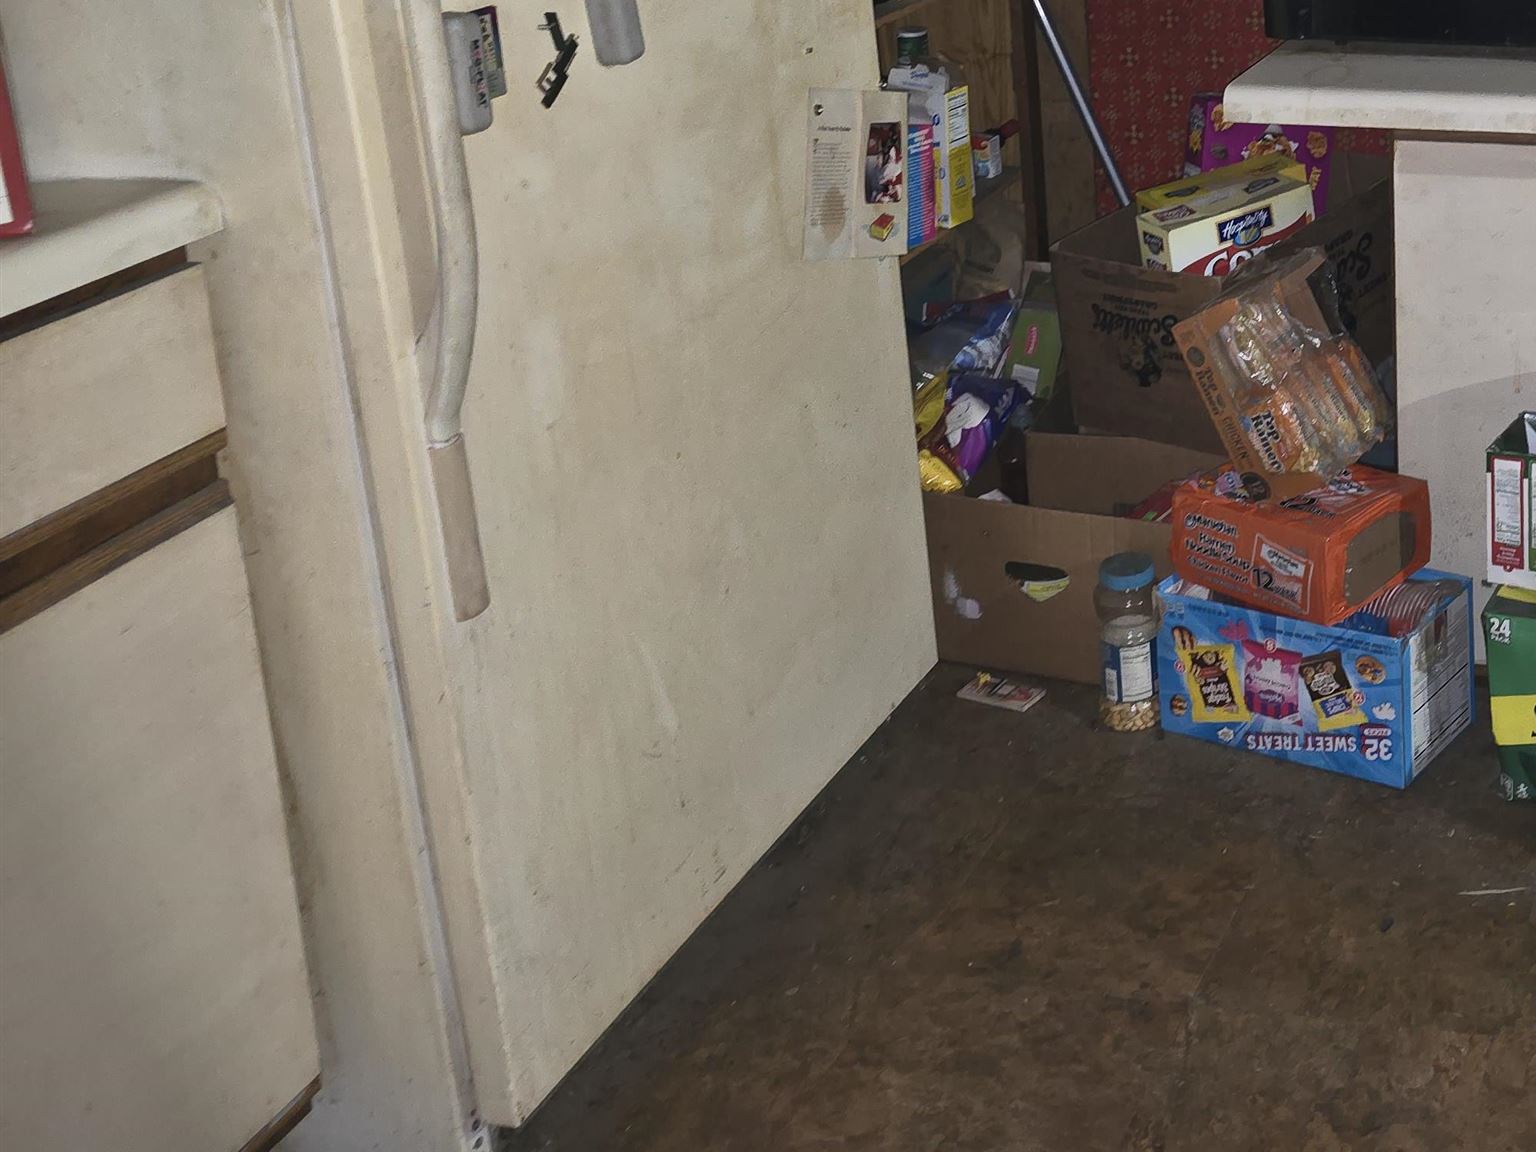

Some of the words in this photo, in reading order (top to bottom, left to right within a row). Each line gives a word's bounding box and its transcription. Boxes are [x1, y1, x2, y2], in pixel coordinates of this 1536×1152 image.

[1219, 414, 1254, 460] CHICKEN
[1257, 410, 1285, 444] Top
[1245, 414, 1290, 476] Ramen
[1253, 568, 1273, 589] 12
[1489, 618, 1511, 637] 24
[1247, 733, 1300, 751] TREATS
[1306, 733, 1357, 753] SWEET
[1365, 738, 1392, 761] 32
